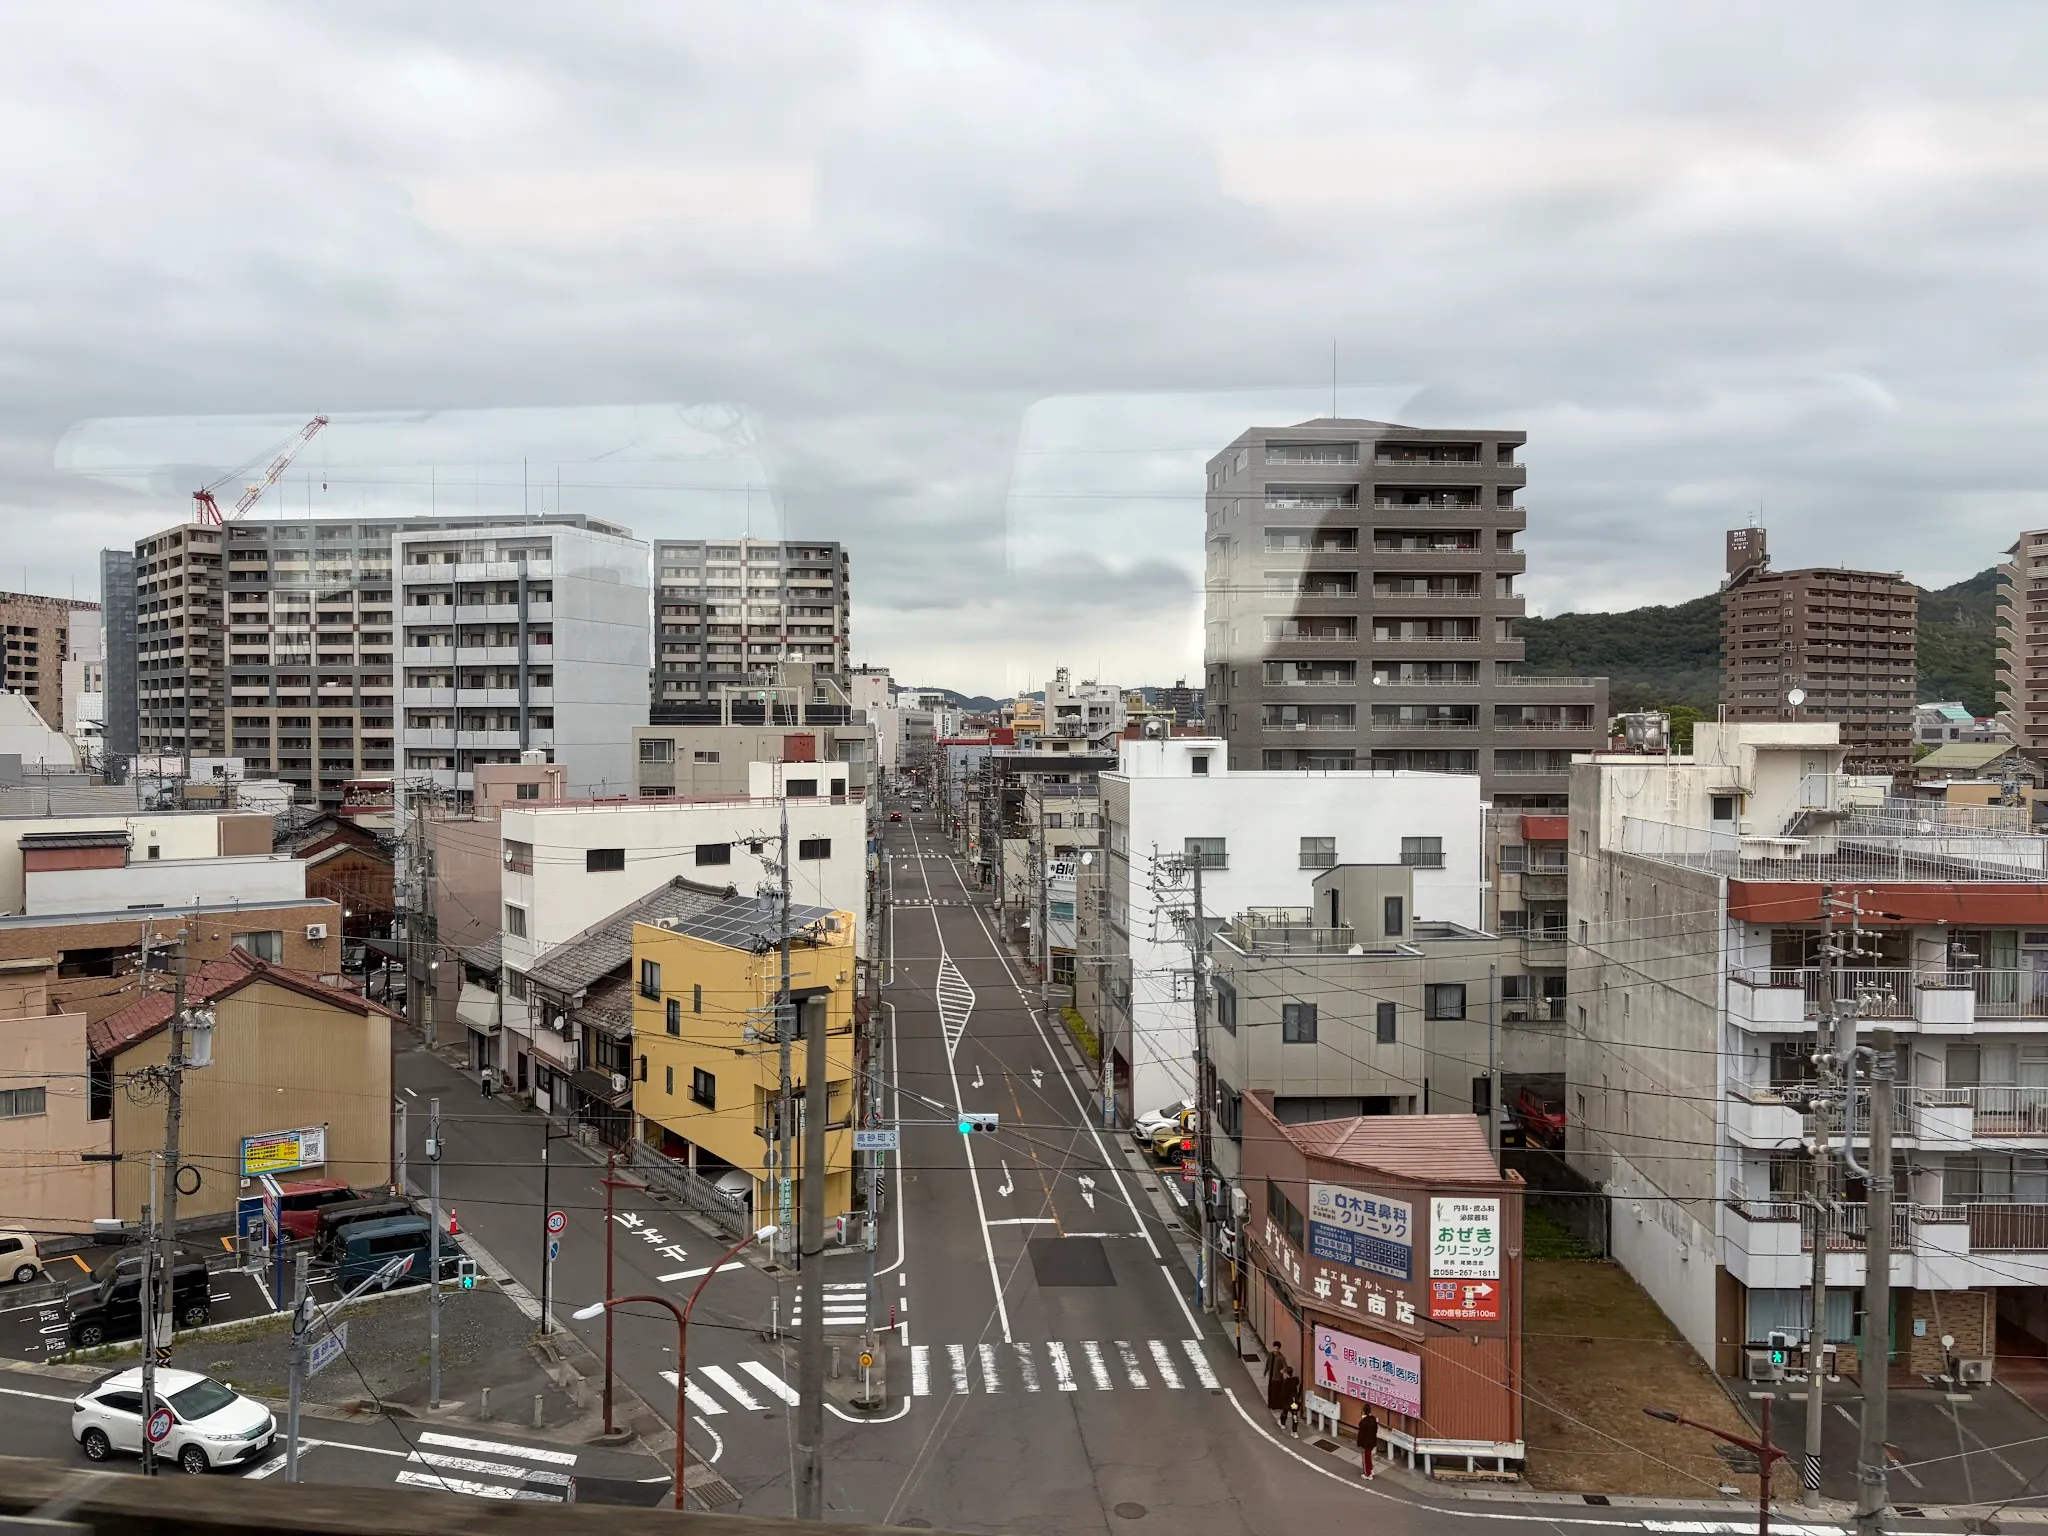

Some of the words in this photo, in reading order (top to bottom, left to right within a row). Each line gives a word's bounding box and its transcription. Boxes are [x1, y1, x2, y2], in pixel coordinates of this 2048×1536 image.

[857, 1133, 886, 1142] 高砂町
[889, 1132, 896, 1142] 3
[1453, 1204, 1495, 1212] 内科・皮ふ科
[550, 1216, 562, 1228] 30
[1459, 1214, 1489, 1222] 泌尿器科
[1340, 1210, 1407, 1238] クリニック
[1437, 1226, 1492, 1243] おぜき
[1434, 1244, 1495, 1257] クリニック
[1440, 1269, 1496, 1277] 058-267-1811
[1432, 1308, 1496, 1318] 次の信号右折100m
